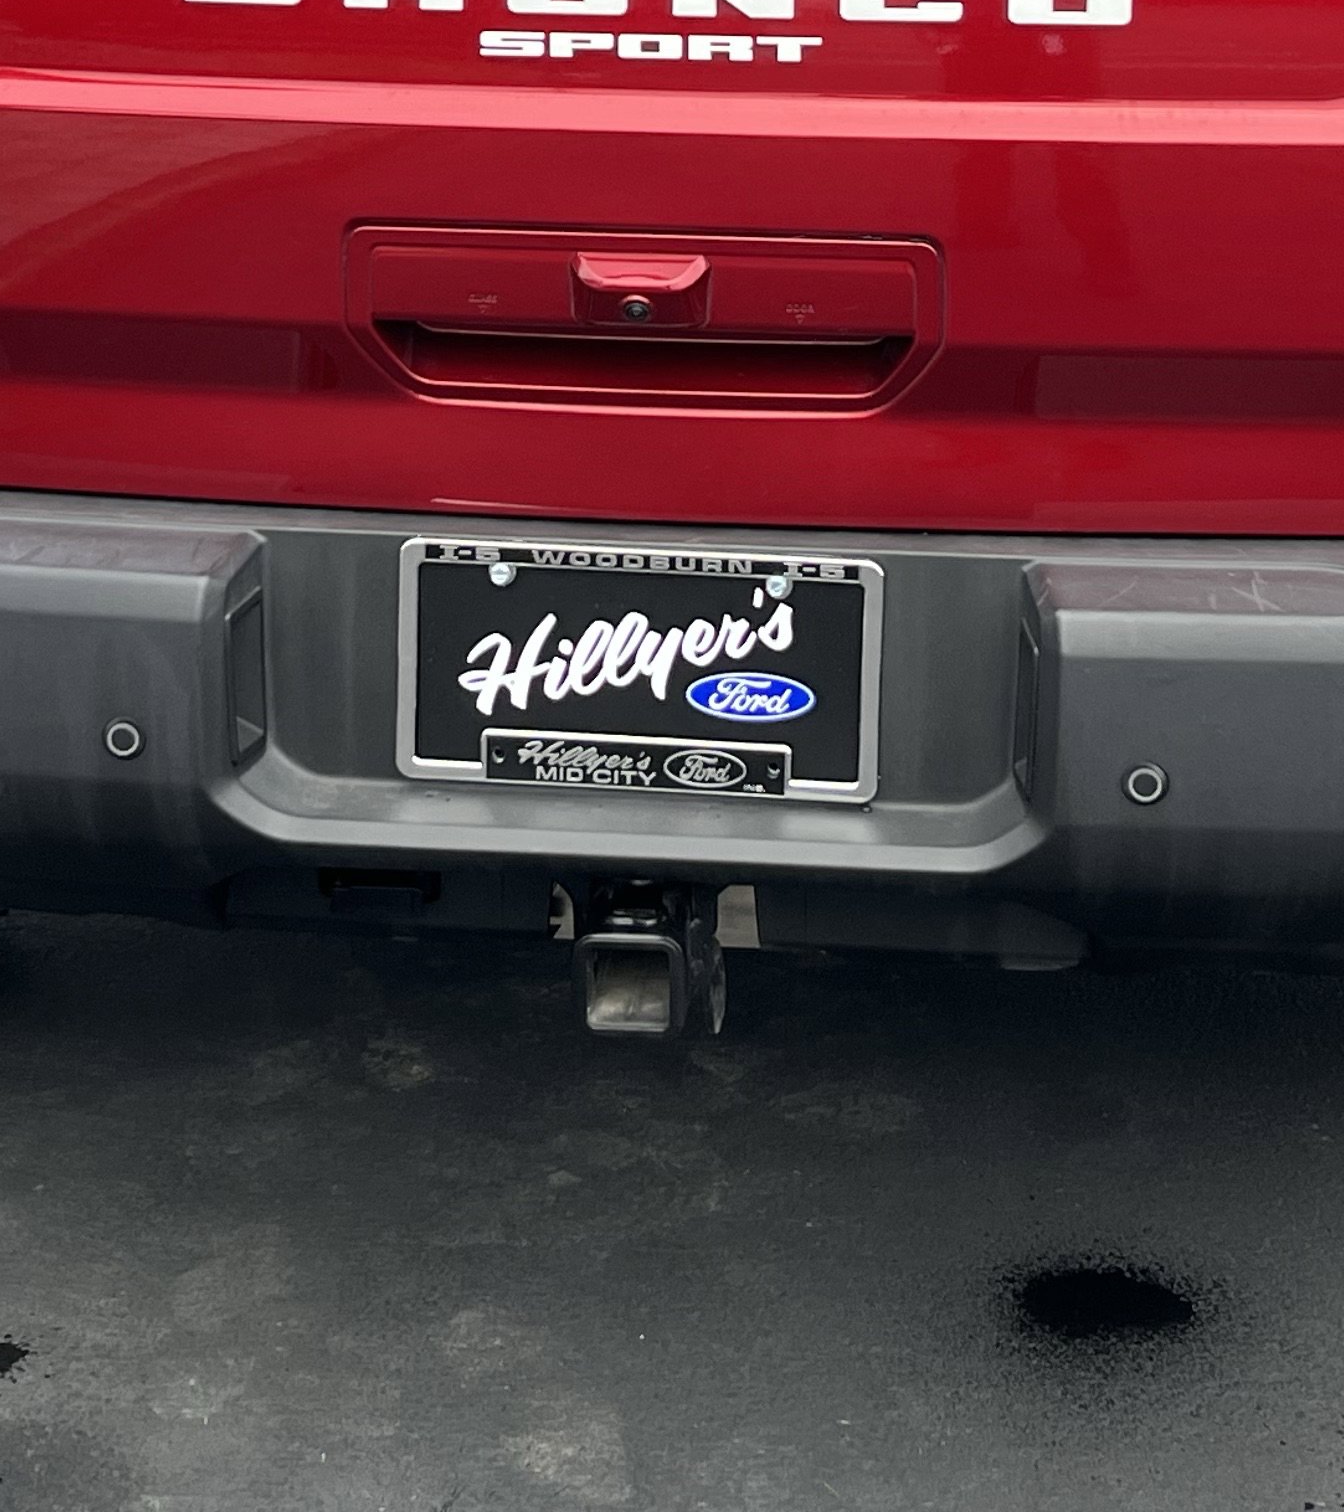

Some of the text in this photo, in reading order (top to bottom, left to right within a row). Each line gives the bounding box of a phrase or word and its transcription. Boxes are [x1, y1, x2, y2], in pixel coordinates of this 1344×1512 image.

[478, 29, 823, 63] SPORT
[438, 544, 847, 580] I-5 WOODBURN I-5
[458, 587, 795, 716] Hillyer's
[707, 675, 792, 715] Ford
[517, 738, 653, 775] Hillyer's
[677, 752, 732, 786] Ford
[535, 764, 658, 790] MID CITY
